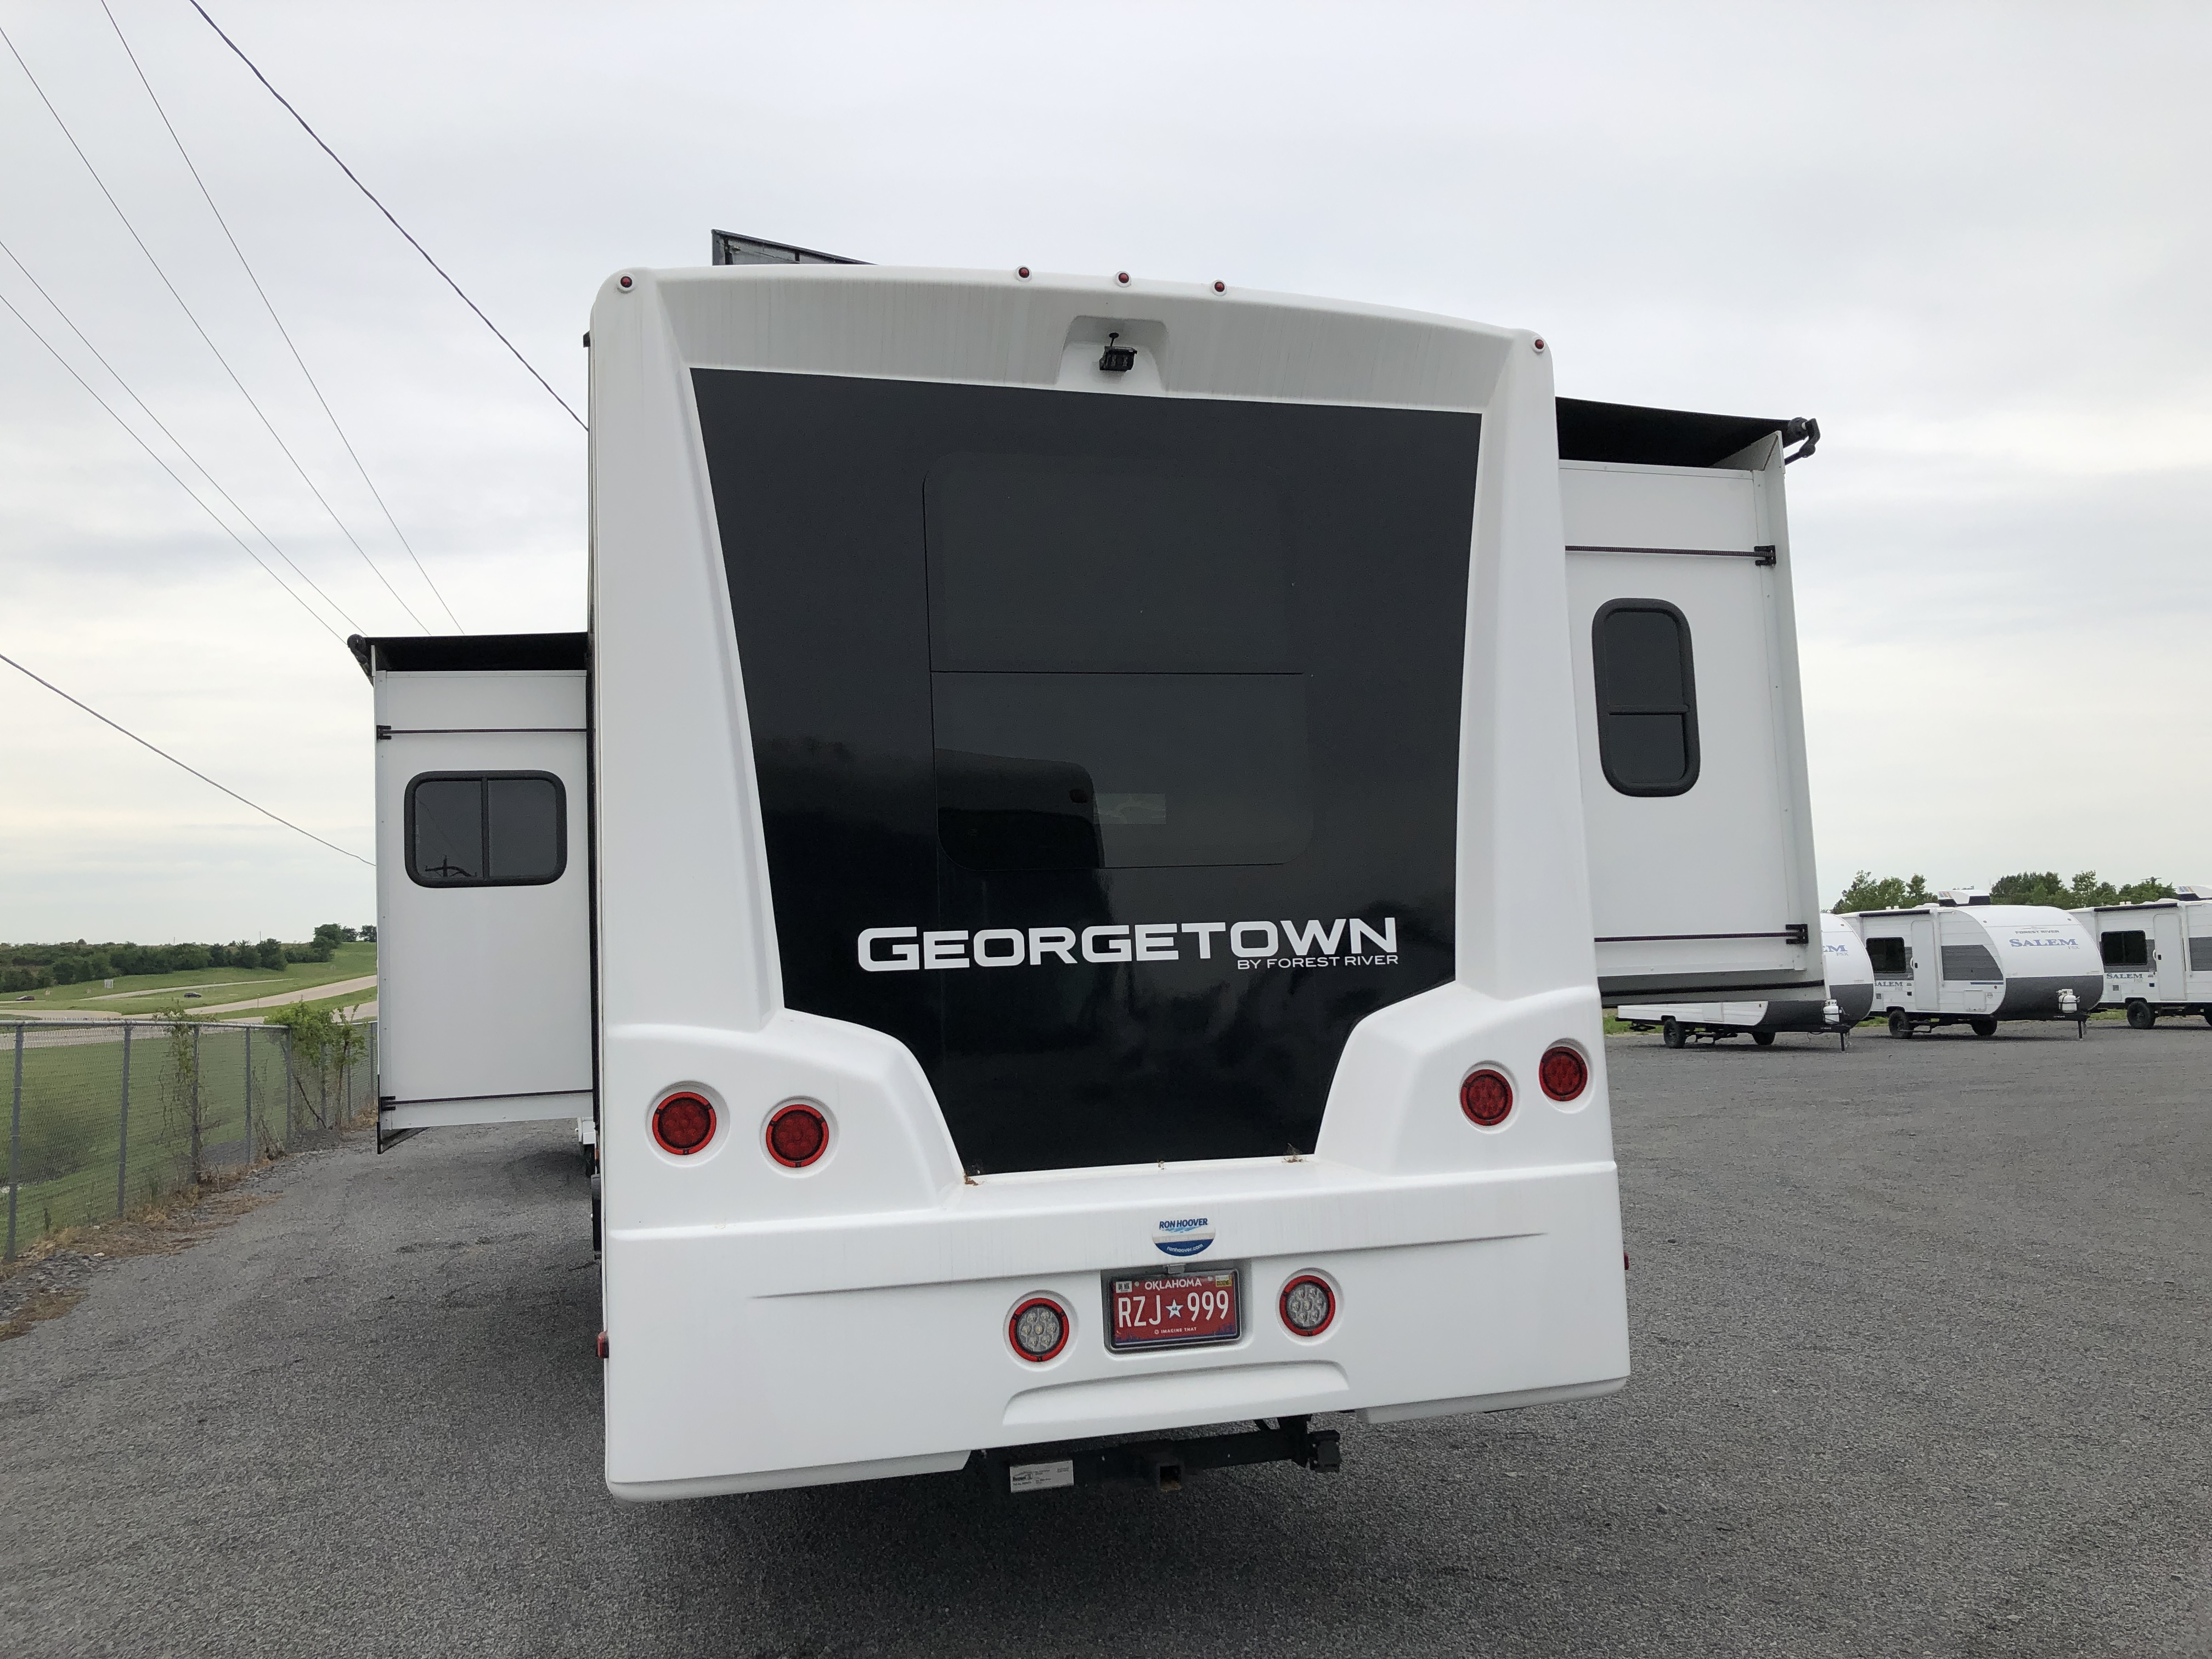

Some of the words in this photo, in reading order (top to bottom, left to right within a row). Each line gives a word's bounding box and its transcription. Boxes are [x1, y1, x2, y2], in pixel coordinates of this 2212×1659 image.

[857, 917, 1398, 972] GEORGETOWN
[2008, 939, 2079, 947] SALEM
[1237, 959, 1262, 970] BY
[1267, 956, 1340, 969] FOREST
[1344, 955, 1399, 966] RIVER
[1159, 1220, 1176, 1229] RON
[1176, 1217, 1209, 1227] HOOVER
[1166, 1243, 1204, 1253] ronhoover.com
[1144, 1277, 1203, 1291] OKLAHOMA
[1118, 1295, 1161, 1328] RZJ
[1187, 1290, 1229, 1322] 999
